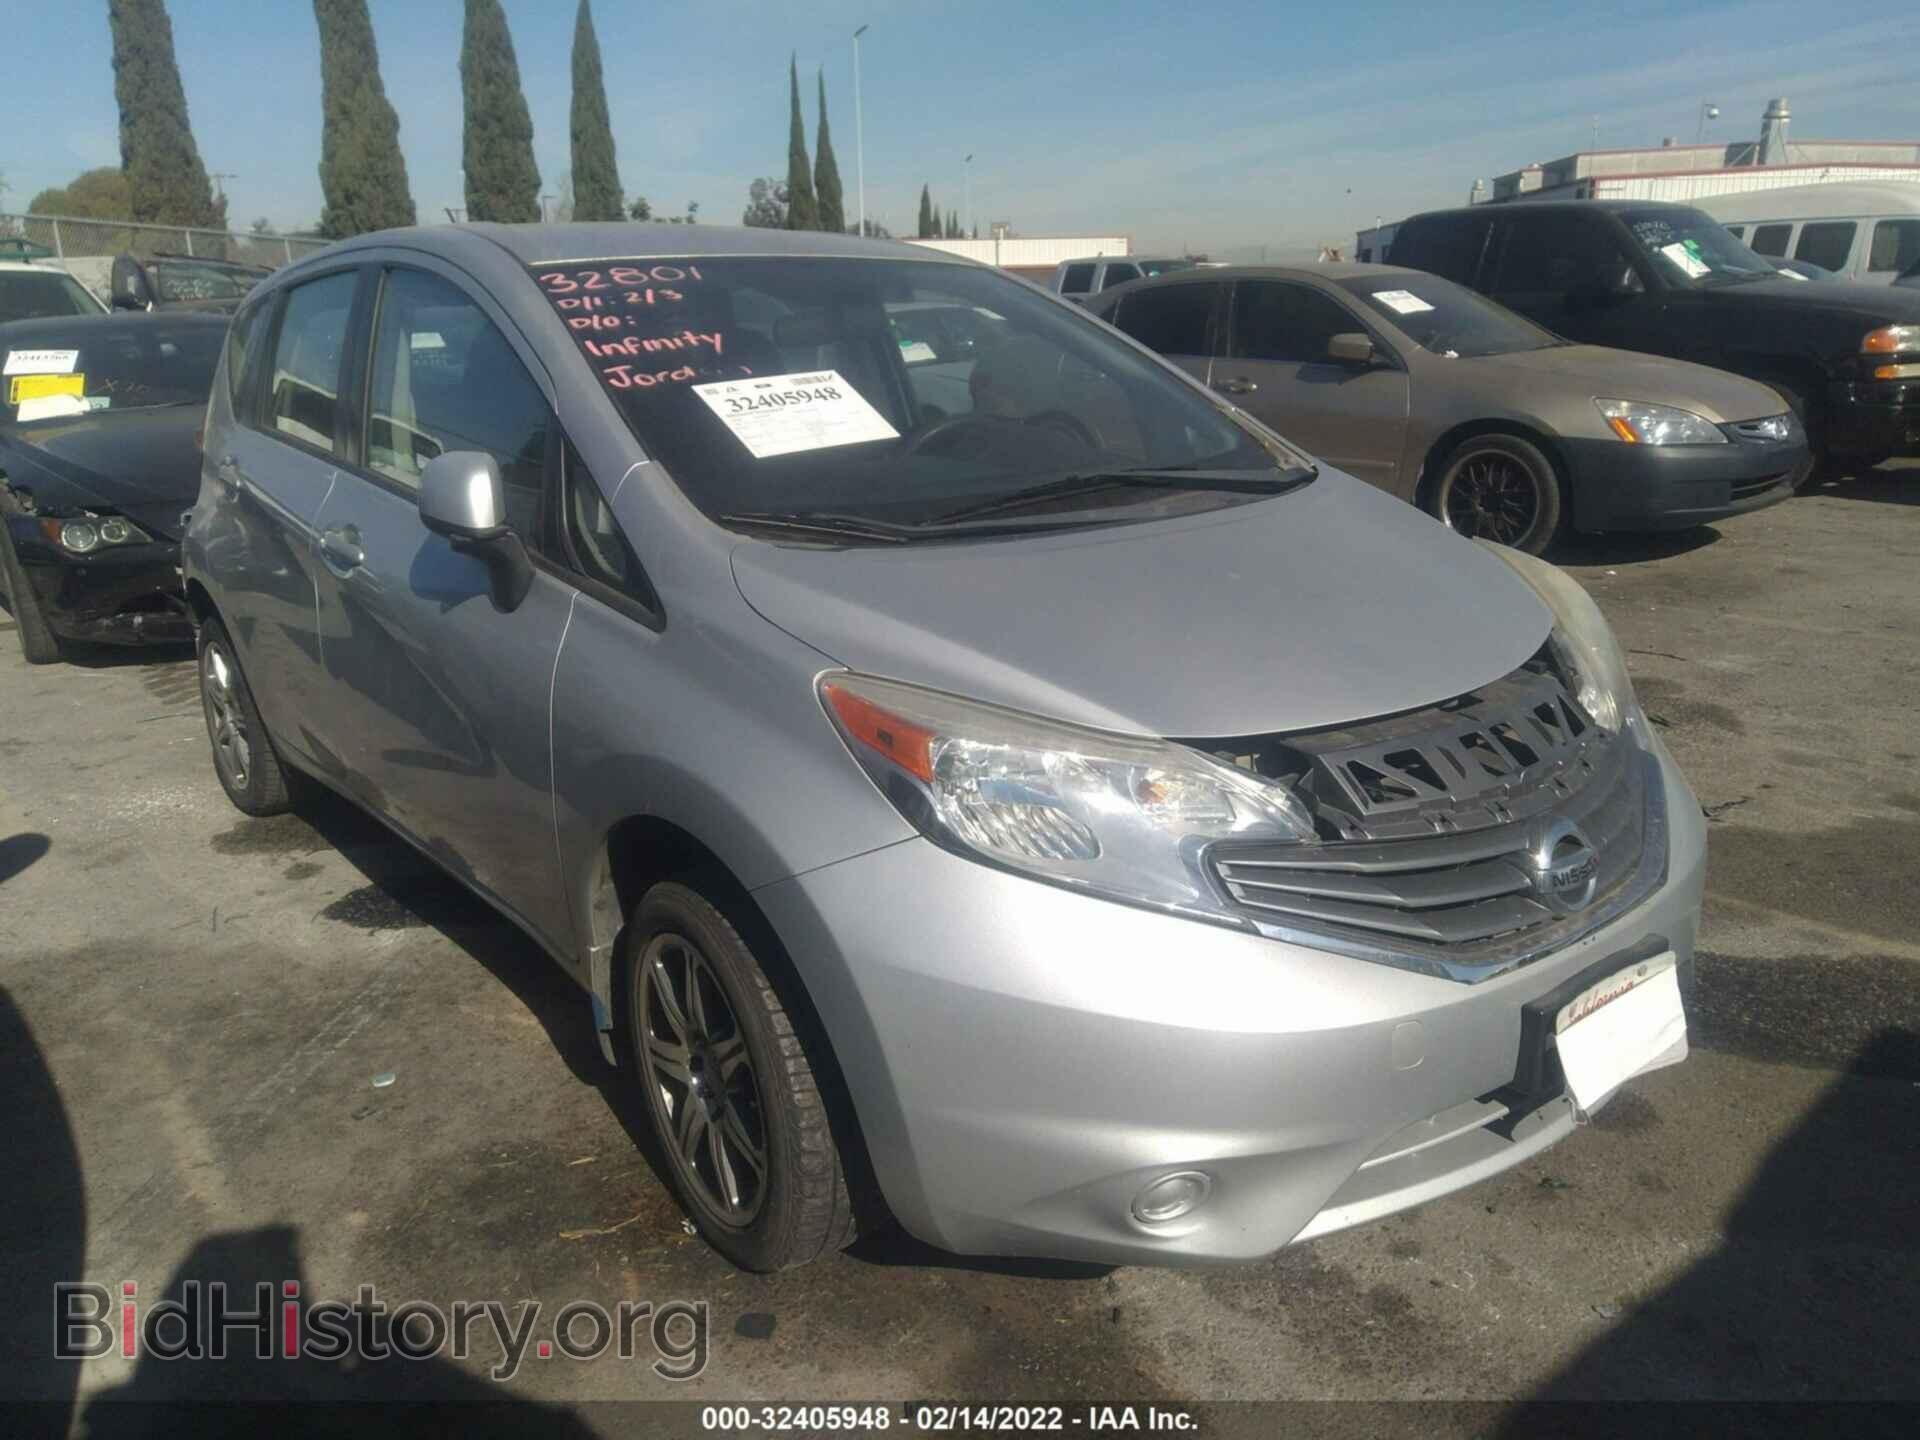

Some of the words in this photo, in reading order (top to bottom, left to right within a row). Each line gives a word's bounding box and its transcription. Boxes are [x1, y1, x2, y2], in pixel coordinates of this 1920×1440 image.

[539, 266, 703, 293] 32801
[584, 330, 722, 357] Infinity
[603, 364, 752, 389] Jord
[725, 386, 843, 413] 32405948
